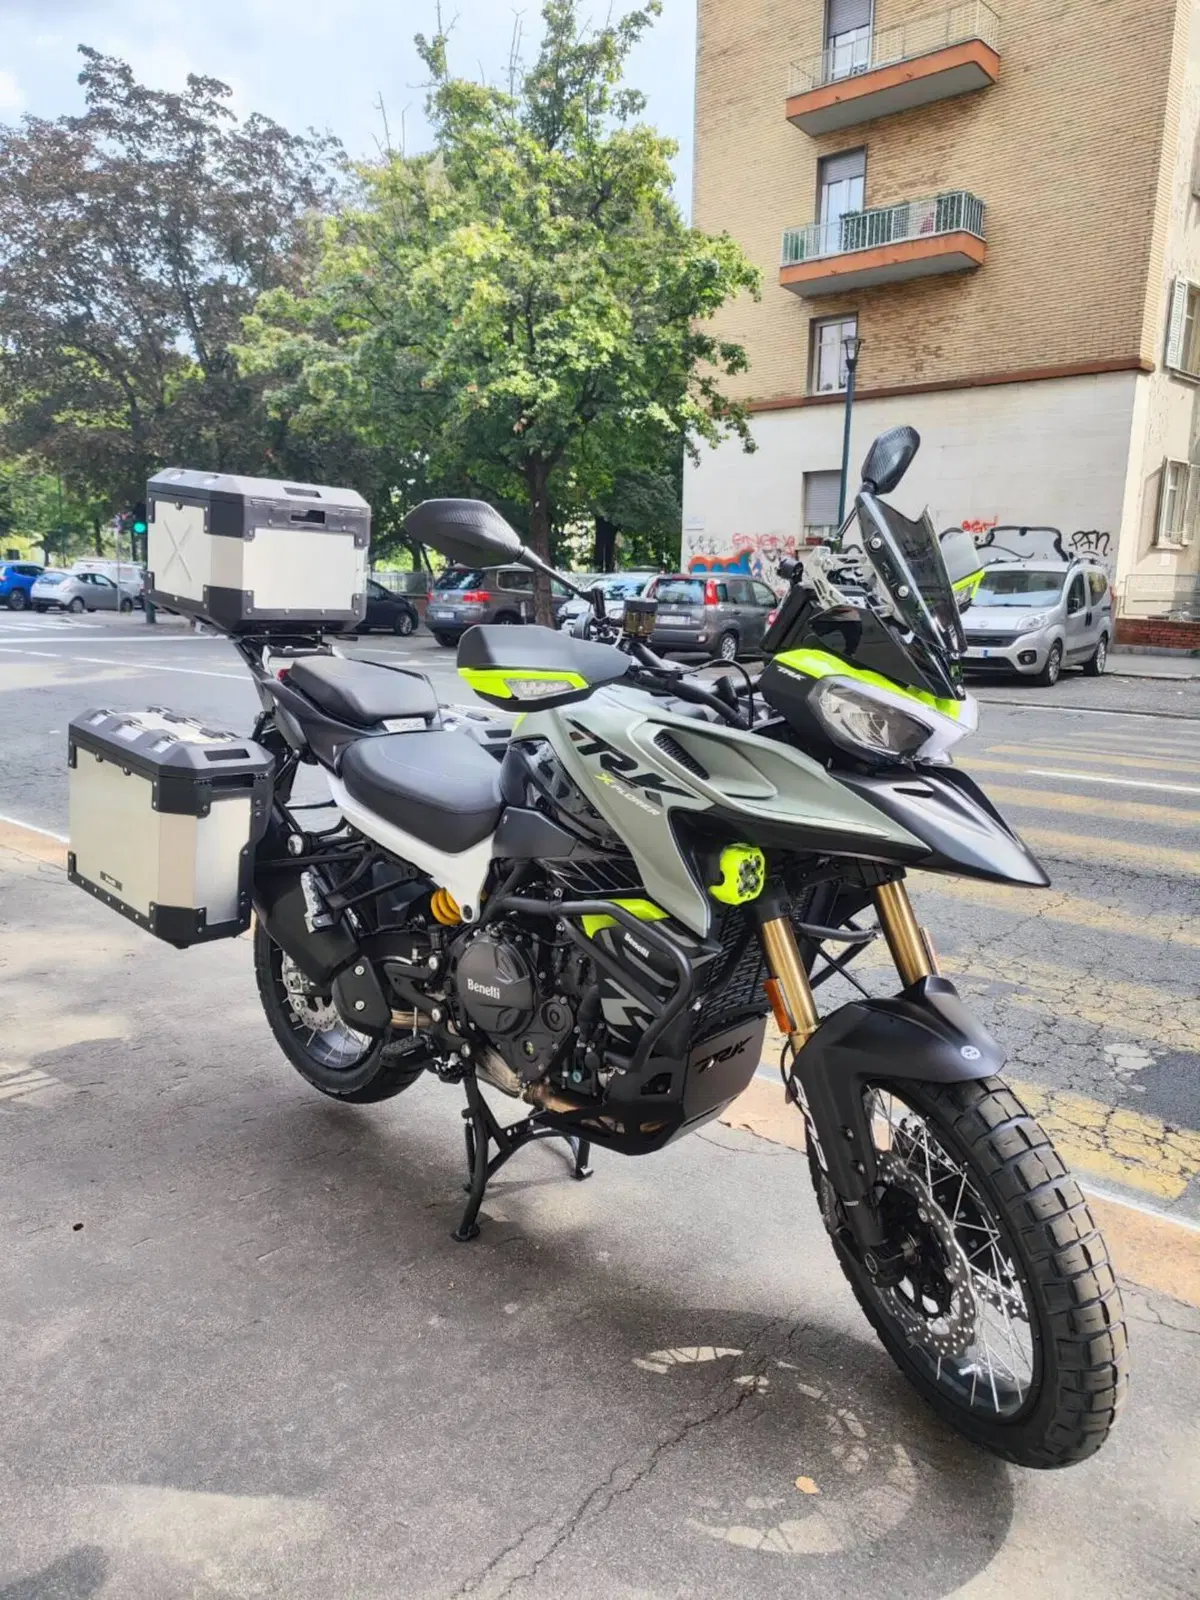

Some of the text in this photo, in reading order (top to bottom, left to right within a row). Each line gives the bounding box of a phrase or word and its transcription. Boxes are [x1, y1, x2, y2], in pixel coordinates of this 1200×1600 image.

[777, 665, 807, 681] TRK
[565, 718, 699, 808] TRK
[624, 932, 650, 958] Benelli
[467, 978, 501, 1000] Benelli
[694, 1035, 755, 1074] TRK
